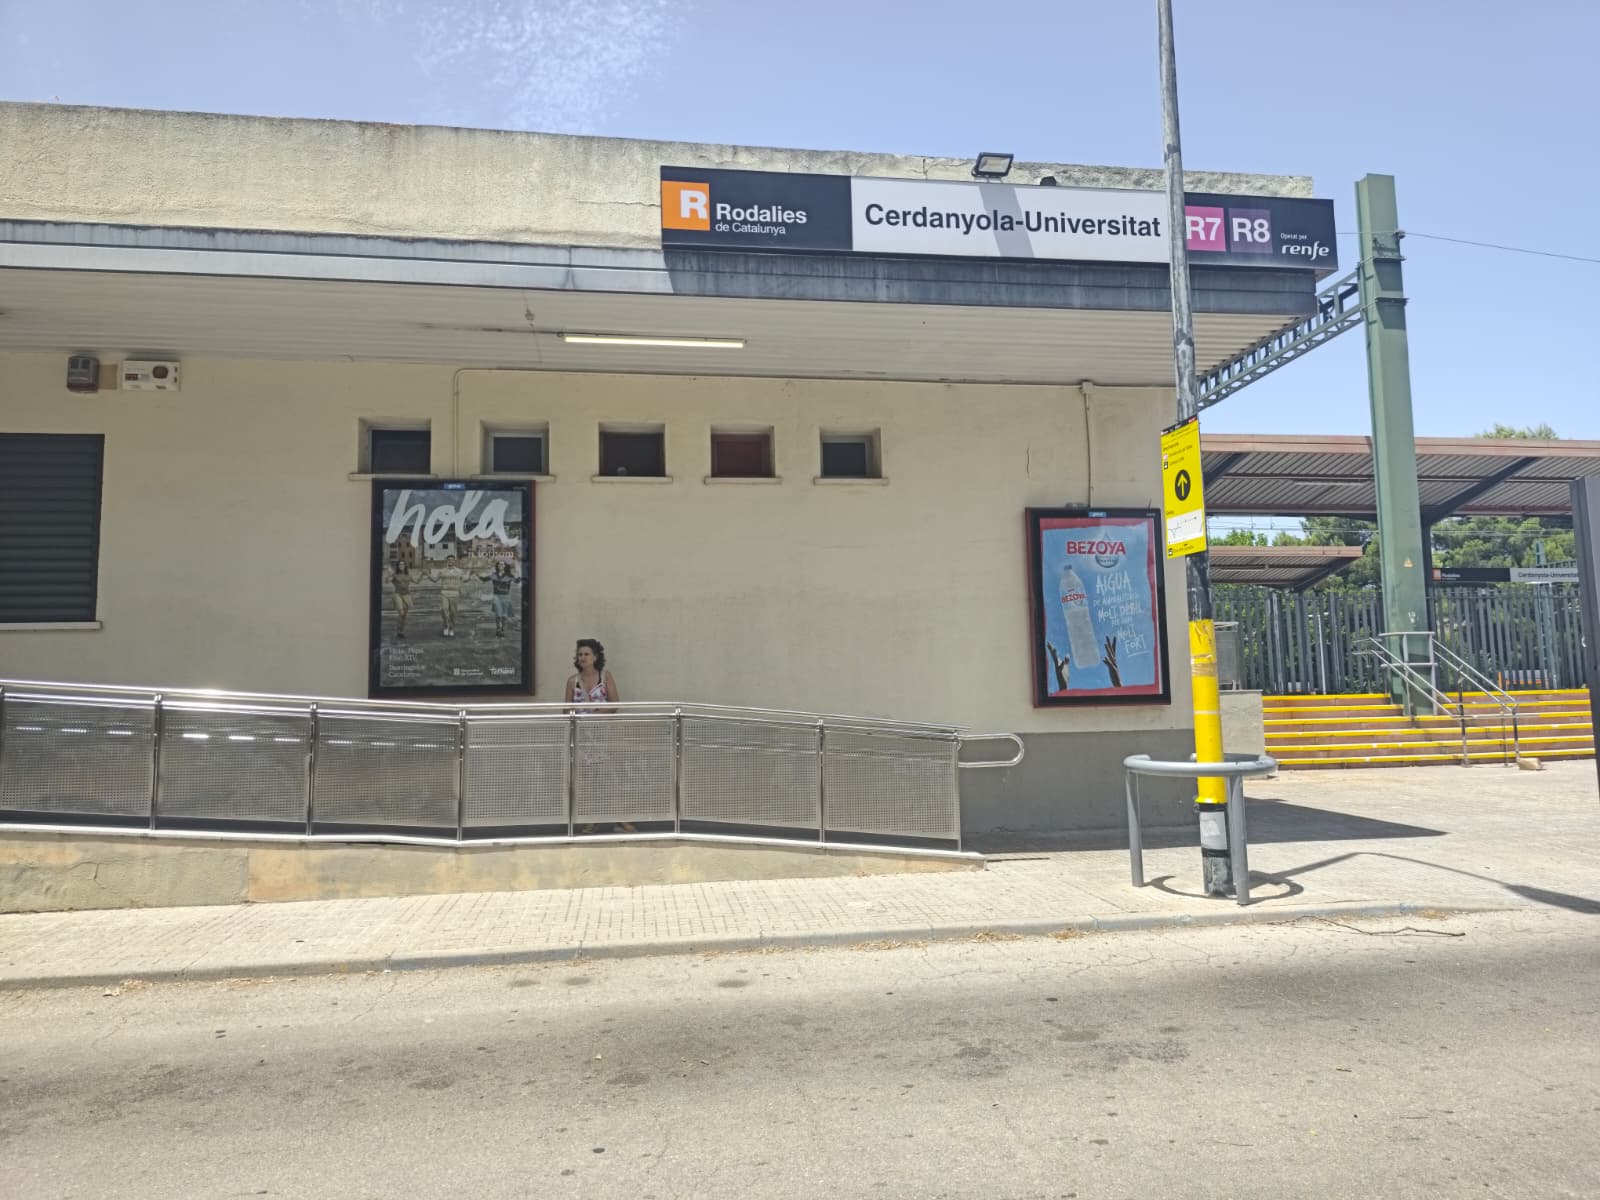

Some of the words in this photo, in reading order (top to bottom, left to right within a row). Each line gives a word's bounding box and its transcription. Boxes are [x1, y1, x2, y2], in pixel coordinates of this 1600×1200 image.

[679, 189, 708, 219] R
[715, 203, 808, 224] Rodalies
[715, 222, 730, 232] de
[732, 222, 786, 235] Catalunya
[865, 203, 1161, 238] Cerdanyola-Universitat
[1185, 215, 1221, 241] R7
[1232, 217, 1271, 244] R8
[1281, 241, 1330, 261] renfe
[385, 489, 519, 548] hola
[1066, 541, 1126, 555] BEZOYA
[1096, 570, 1132, 595] AIGUA
